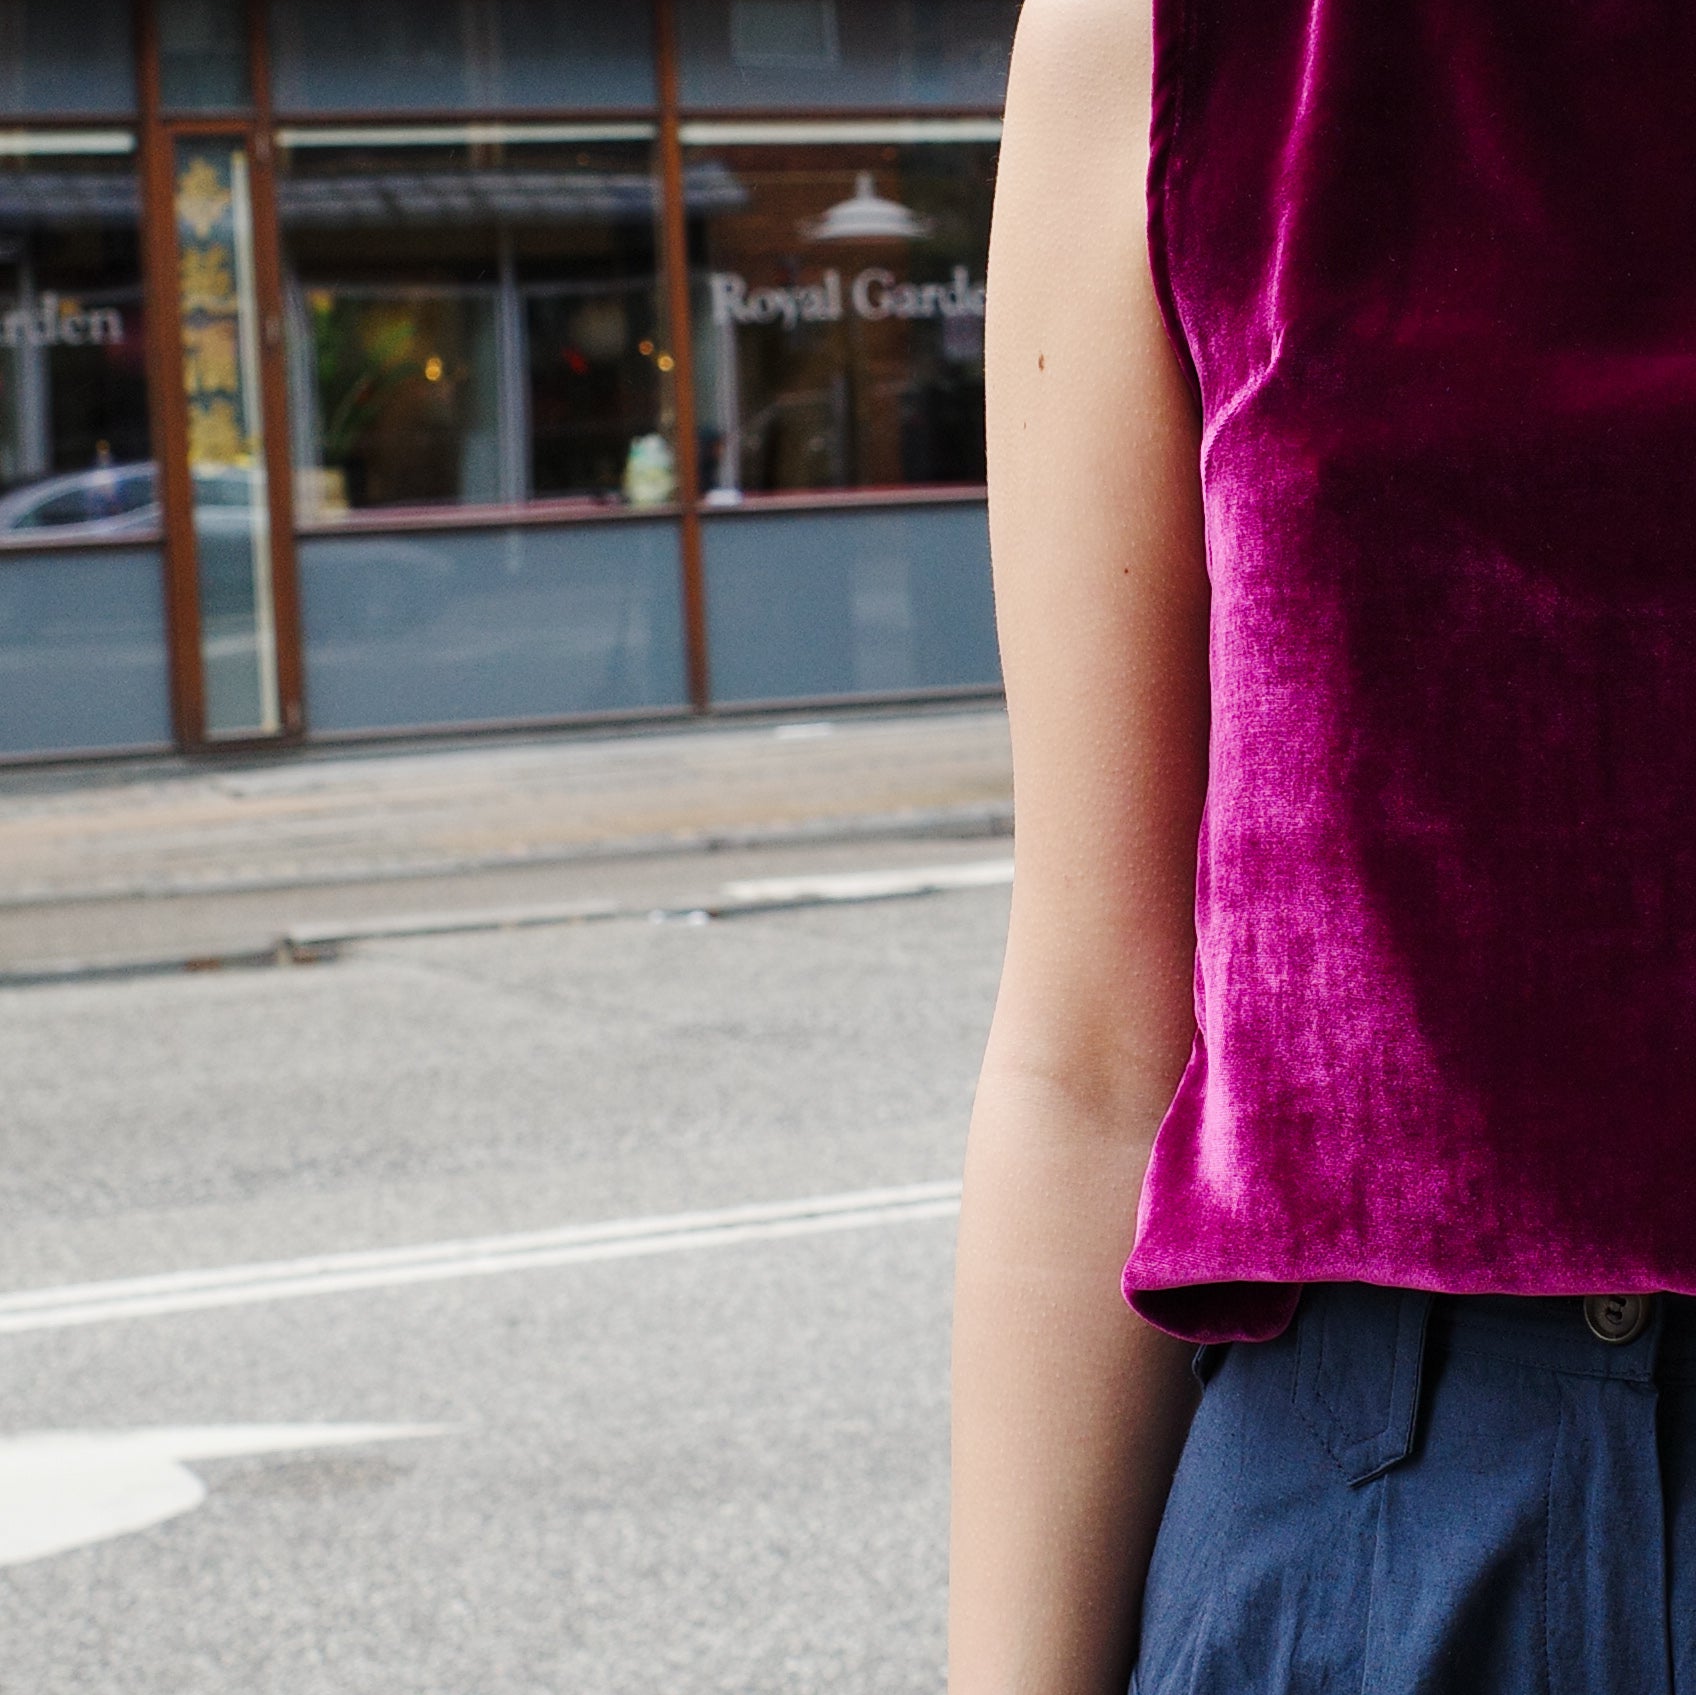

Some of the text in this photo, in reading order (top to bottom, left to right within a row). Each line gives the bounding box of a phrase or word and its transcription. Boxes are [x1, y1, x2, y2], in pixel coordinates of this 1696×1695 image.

[0, 290, 123, 345] rden
[710, 265, 985, 330] Royal Garde
